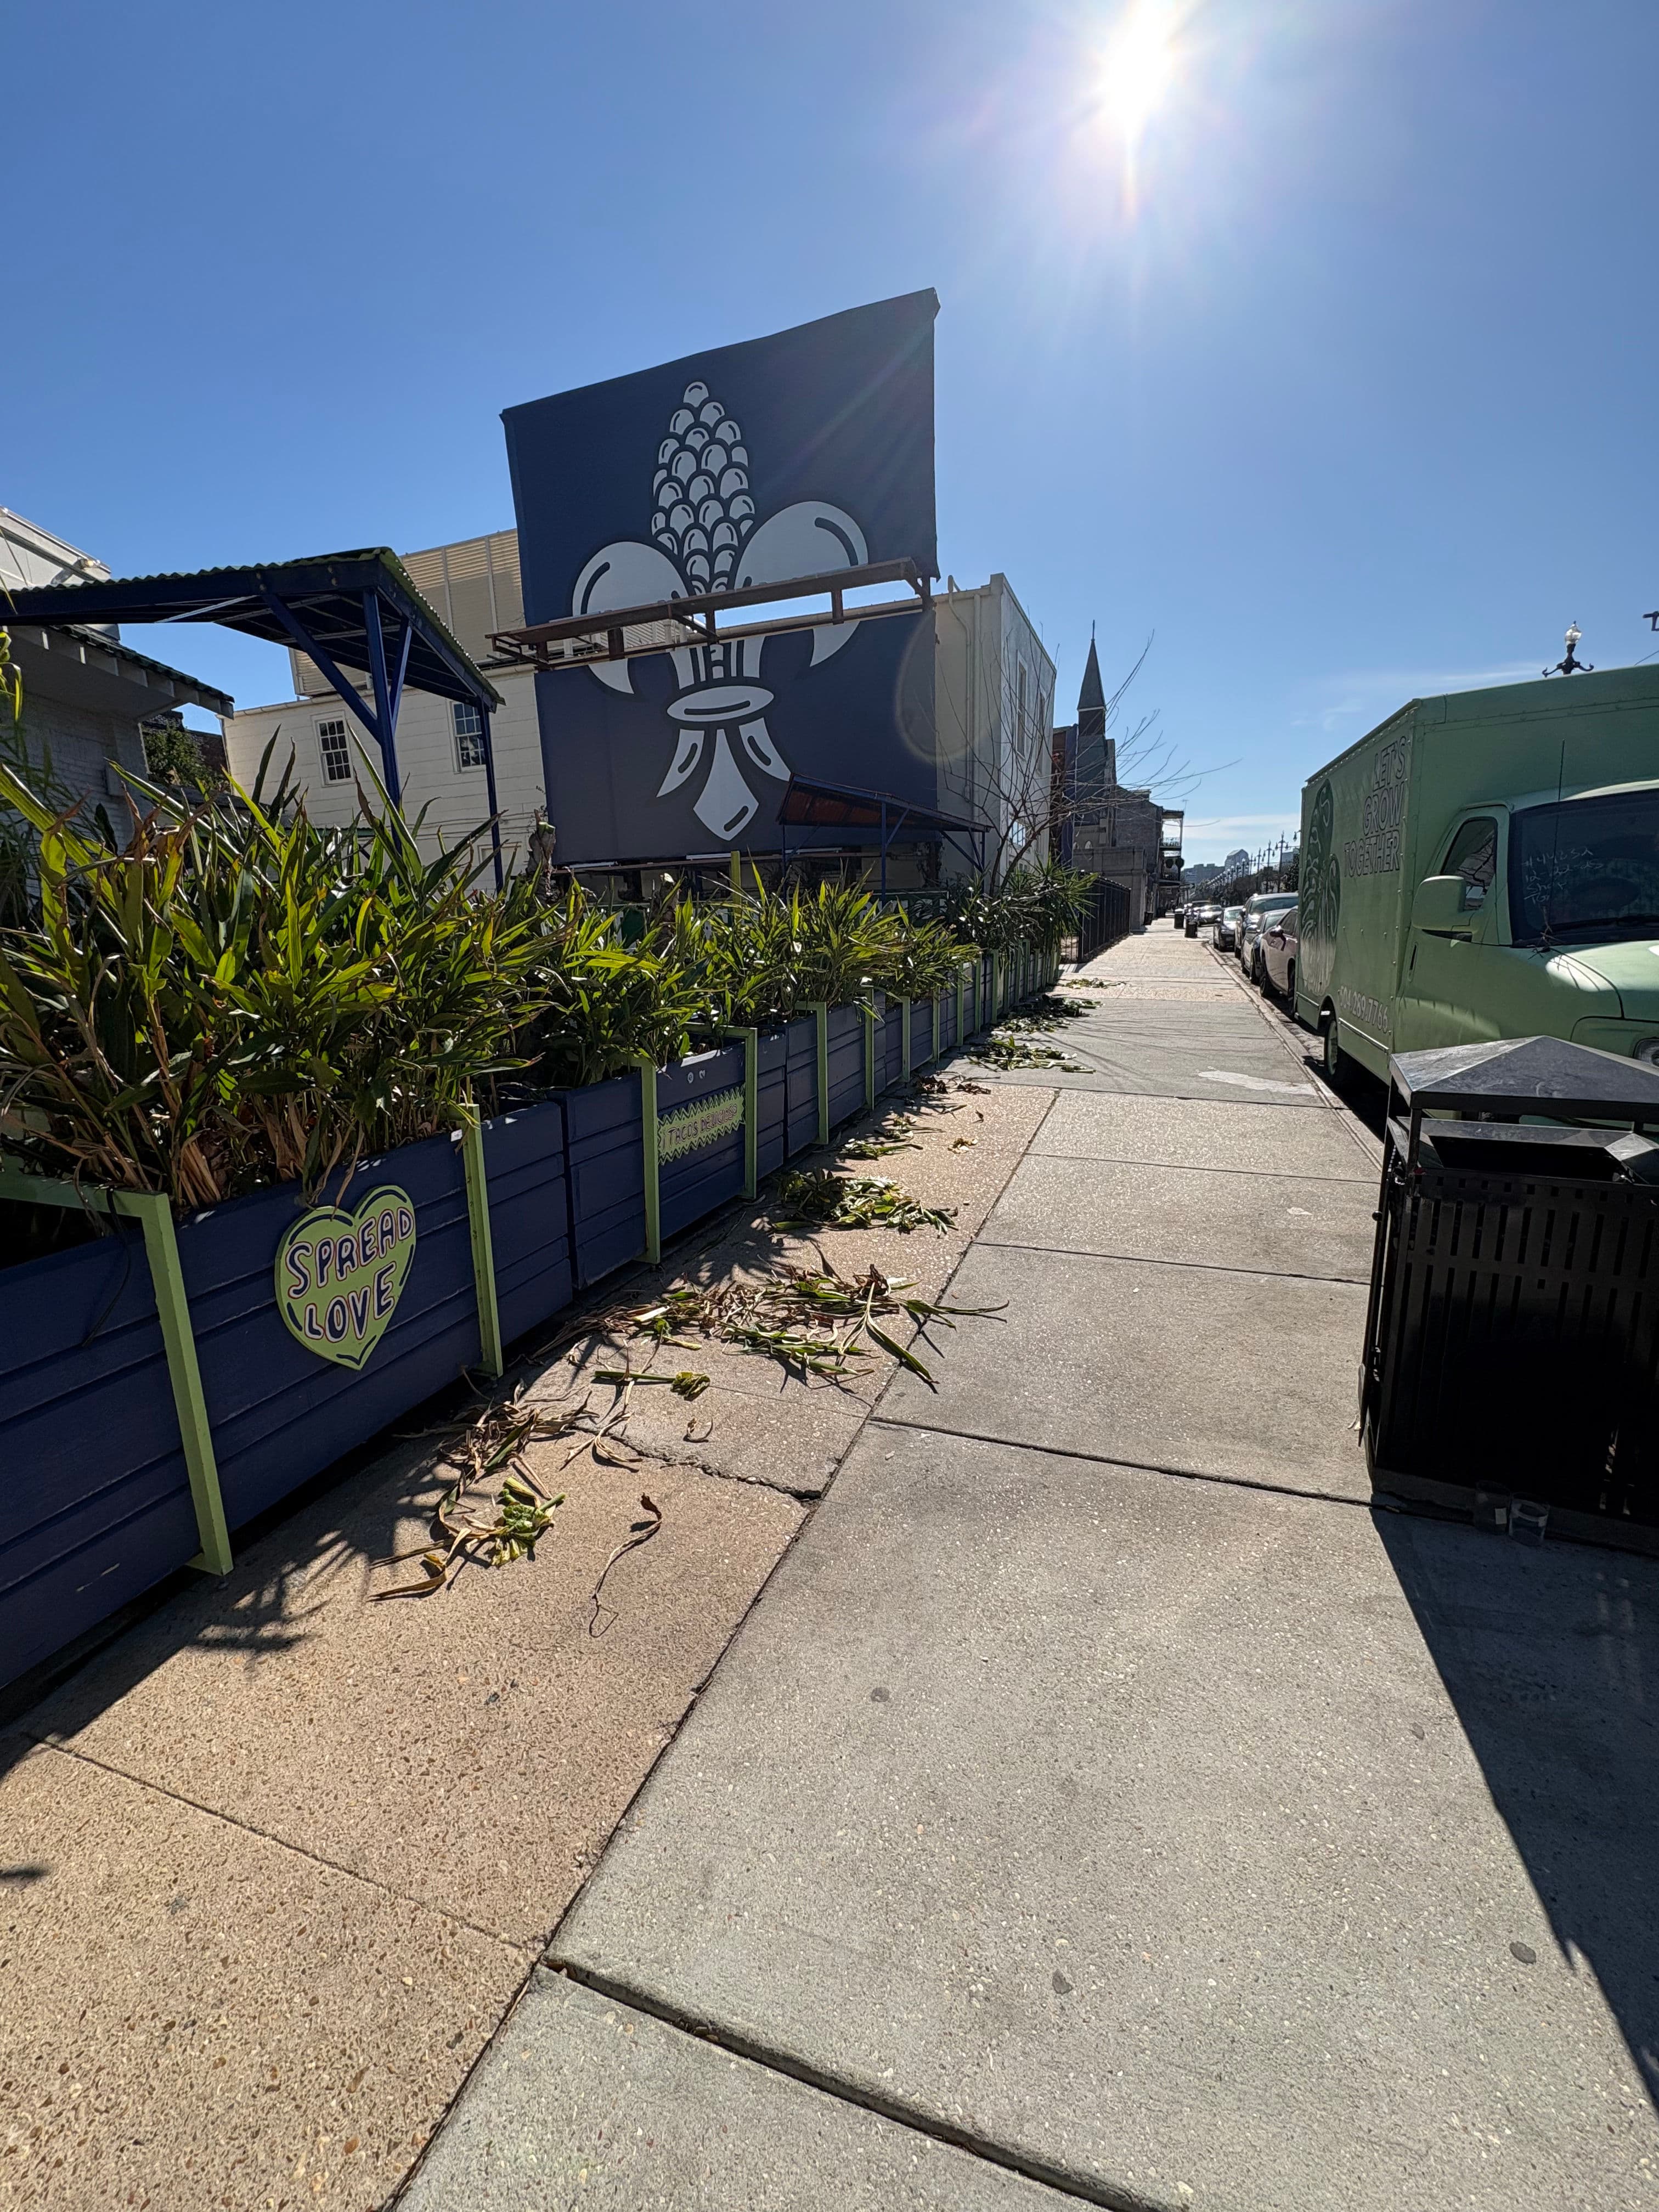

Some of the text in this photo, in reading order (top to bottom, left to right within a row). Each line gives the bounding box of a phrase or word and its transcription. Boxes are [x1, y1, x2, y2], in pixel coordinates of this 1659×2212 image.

[1373, 736, 1406, 792] LET'S
[1363, 781, 1404, 836] GROW
[1344, 830, 1400, 878] TOGETHER
[1338, 985, 1388, 1034] 504.289.7766
[285, 1207, 414, 1299] SPREAD
[304, 1261, 397, 1343] LOVE
